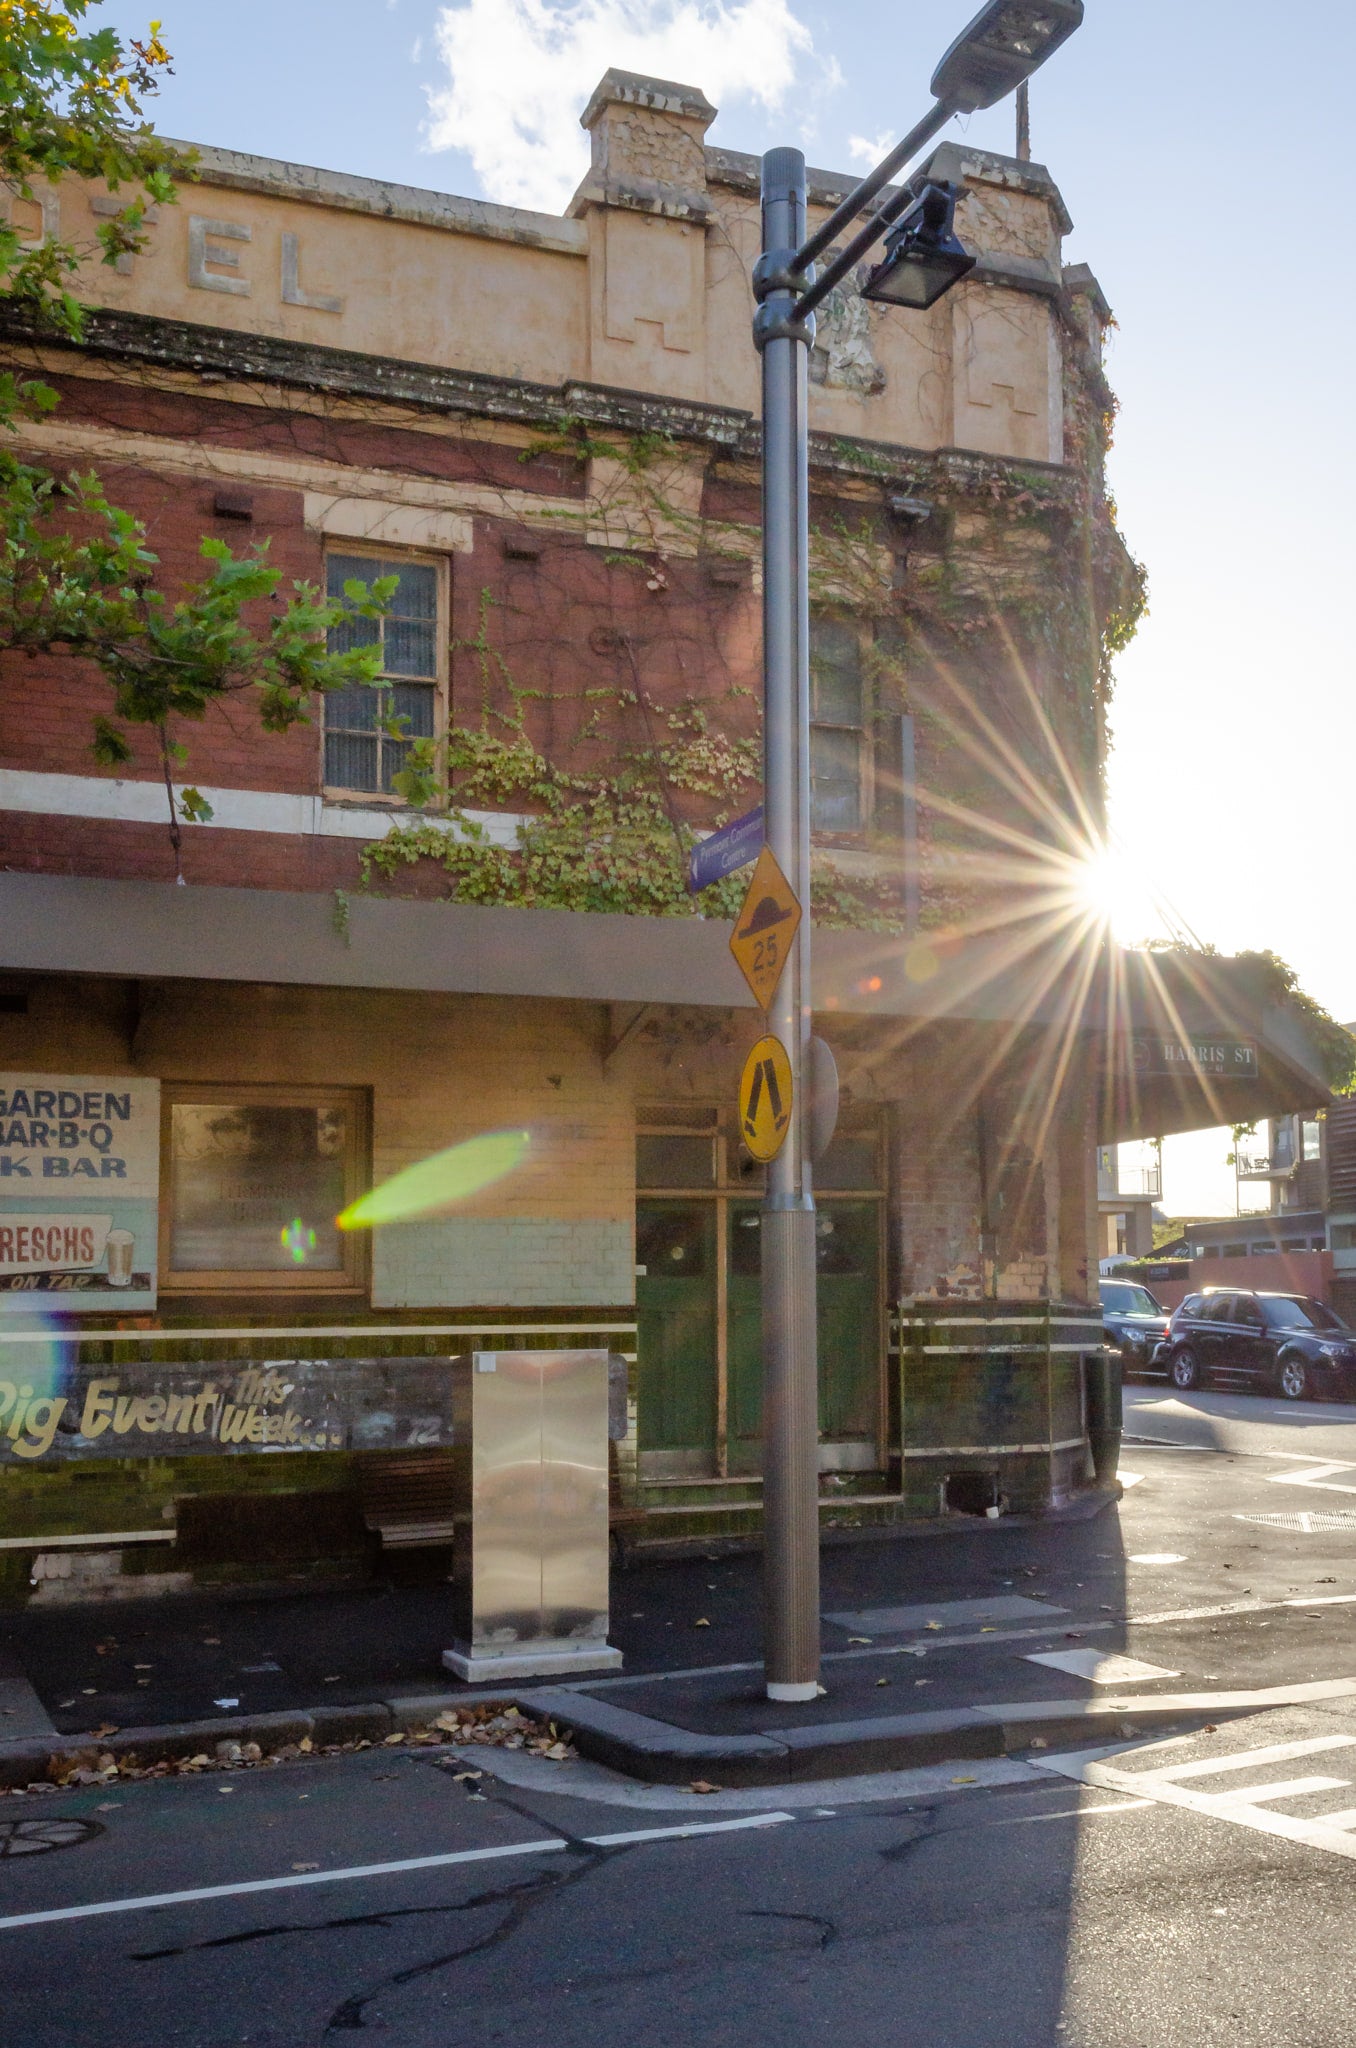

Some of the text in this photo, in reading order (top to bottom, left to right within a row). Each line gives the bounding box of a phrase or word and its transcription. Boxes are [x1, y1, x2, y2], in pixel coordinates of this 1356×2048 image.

[753, 934, 777, 970] 25
[1164, 1044, 1253, 1063] HARRIS ST
[43, 1156, 127, 1178] BAR
[0, 1226, 94, 1262] RESCHS
[10, 1274, 91, 1290] ON TAP
[234, 1369, 290, 1404] This
[80, 1377, 220, 1439] Event
